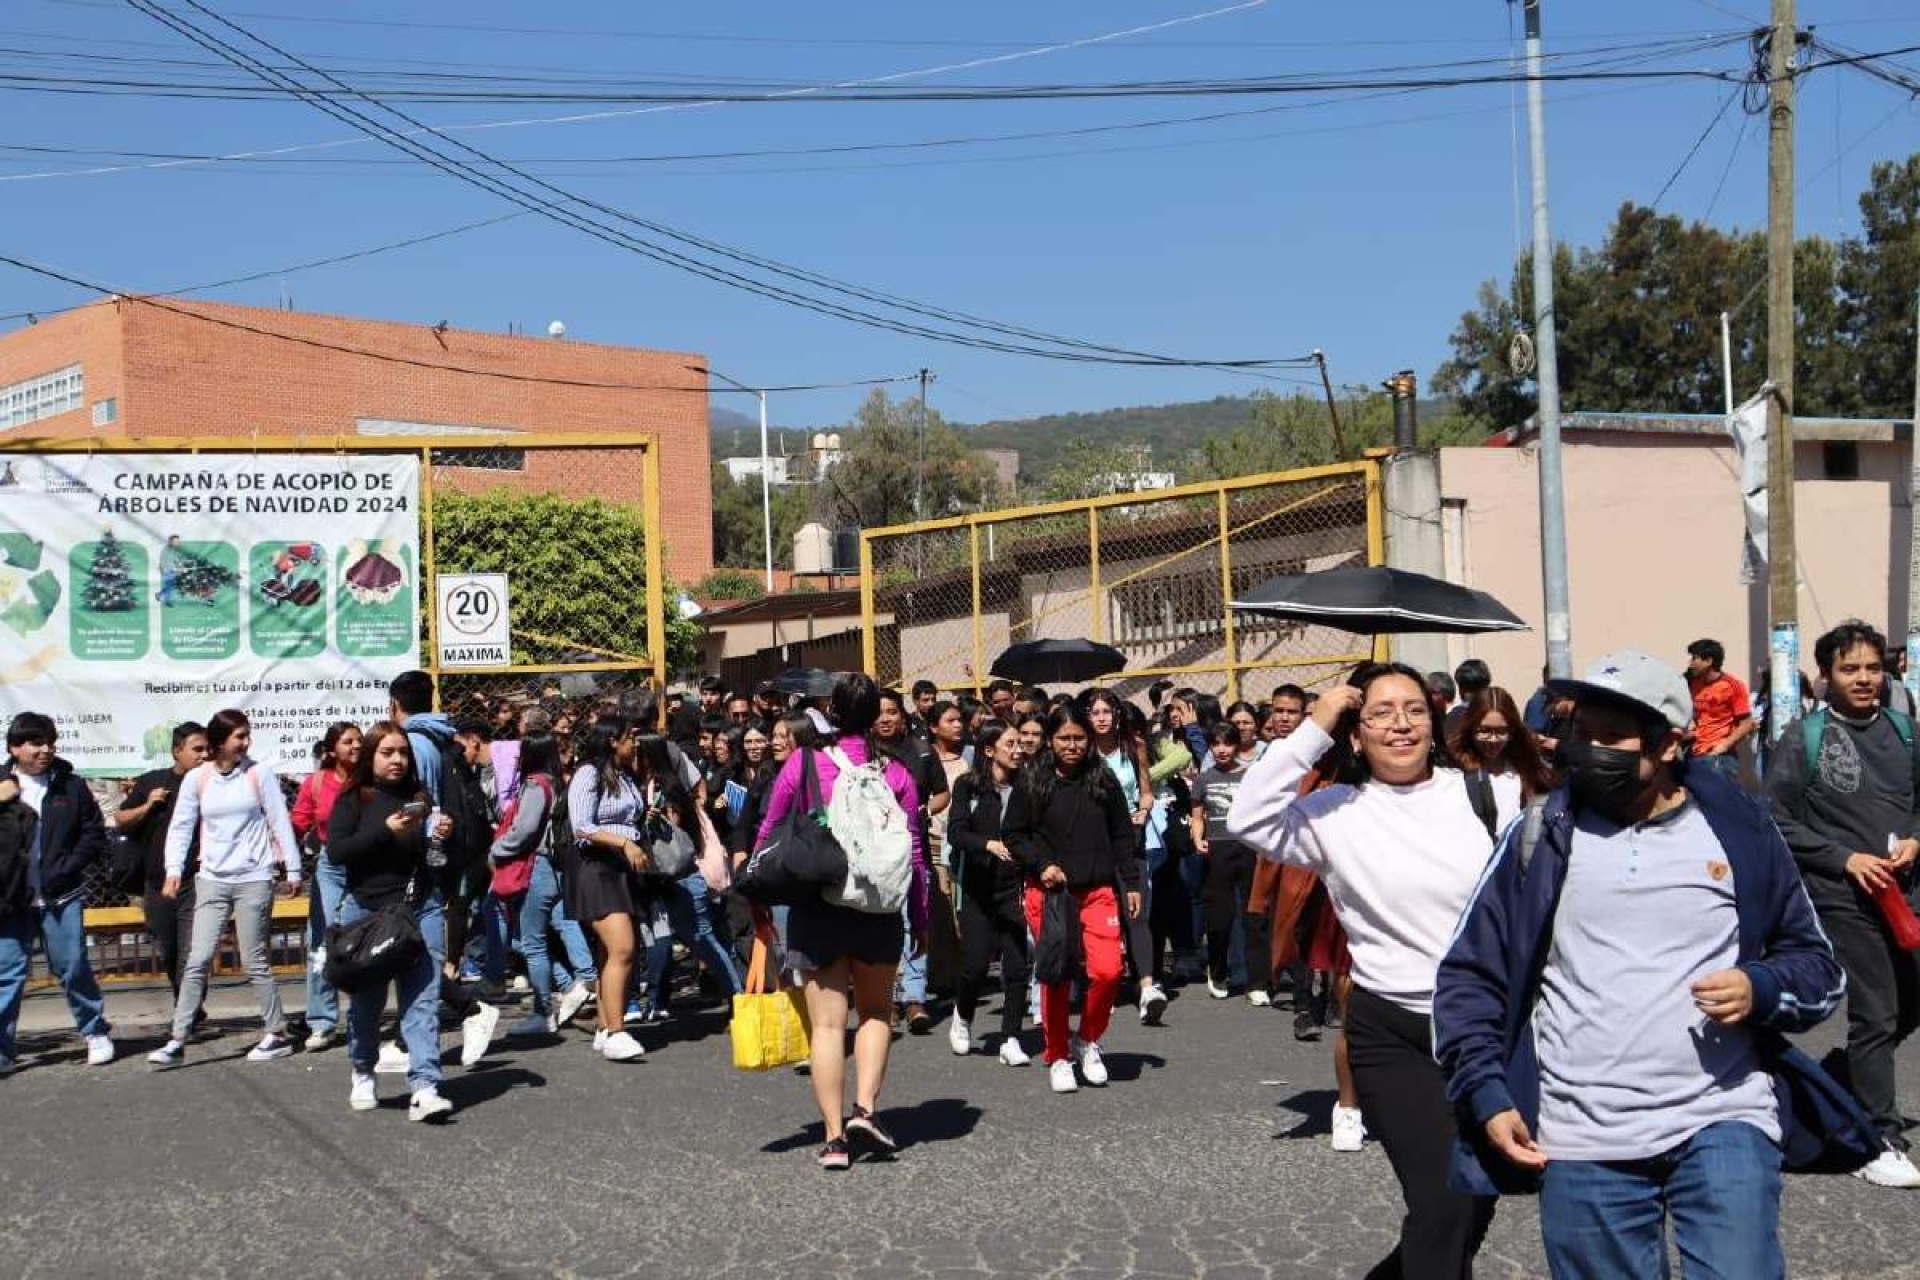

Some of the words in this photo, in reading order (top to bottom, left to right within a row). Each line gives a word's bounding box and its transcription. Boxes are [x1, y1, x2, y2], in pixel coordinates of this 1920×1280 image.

[114, 469, 229, 491] CAMPAÑA
[236, 473, 266, 490] DE
[272, 471, 358, 491] ACOPIO
[366, 472, 393, 490] DE
[99, 493, 201, 513] ÁRBOLES
[209, 496, 239, 513] DE
[245, 496, 349, 513] NAVIDAD
[356, 496, 408, 513] 2024
[455, 590, 489, 616] 20
[444, 647, 504, 661] MAXIMA
[213, 682, 227, 692] tu
[274, 679, 310, 694] partir
[338, 678, 353, 690] 12
[356, 678, 372, 690] de
[78, 713, 113, 724] UAEM
[244, 705, 321, 718] stalaciones
[325, 705, 342, 716] de
[279, 733, 294, 744] de
